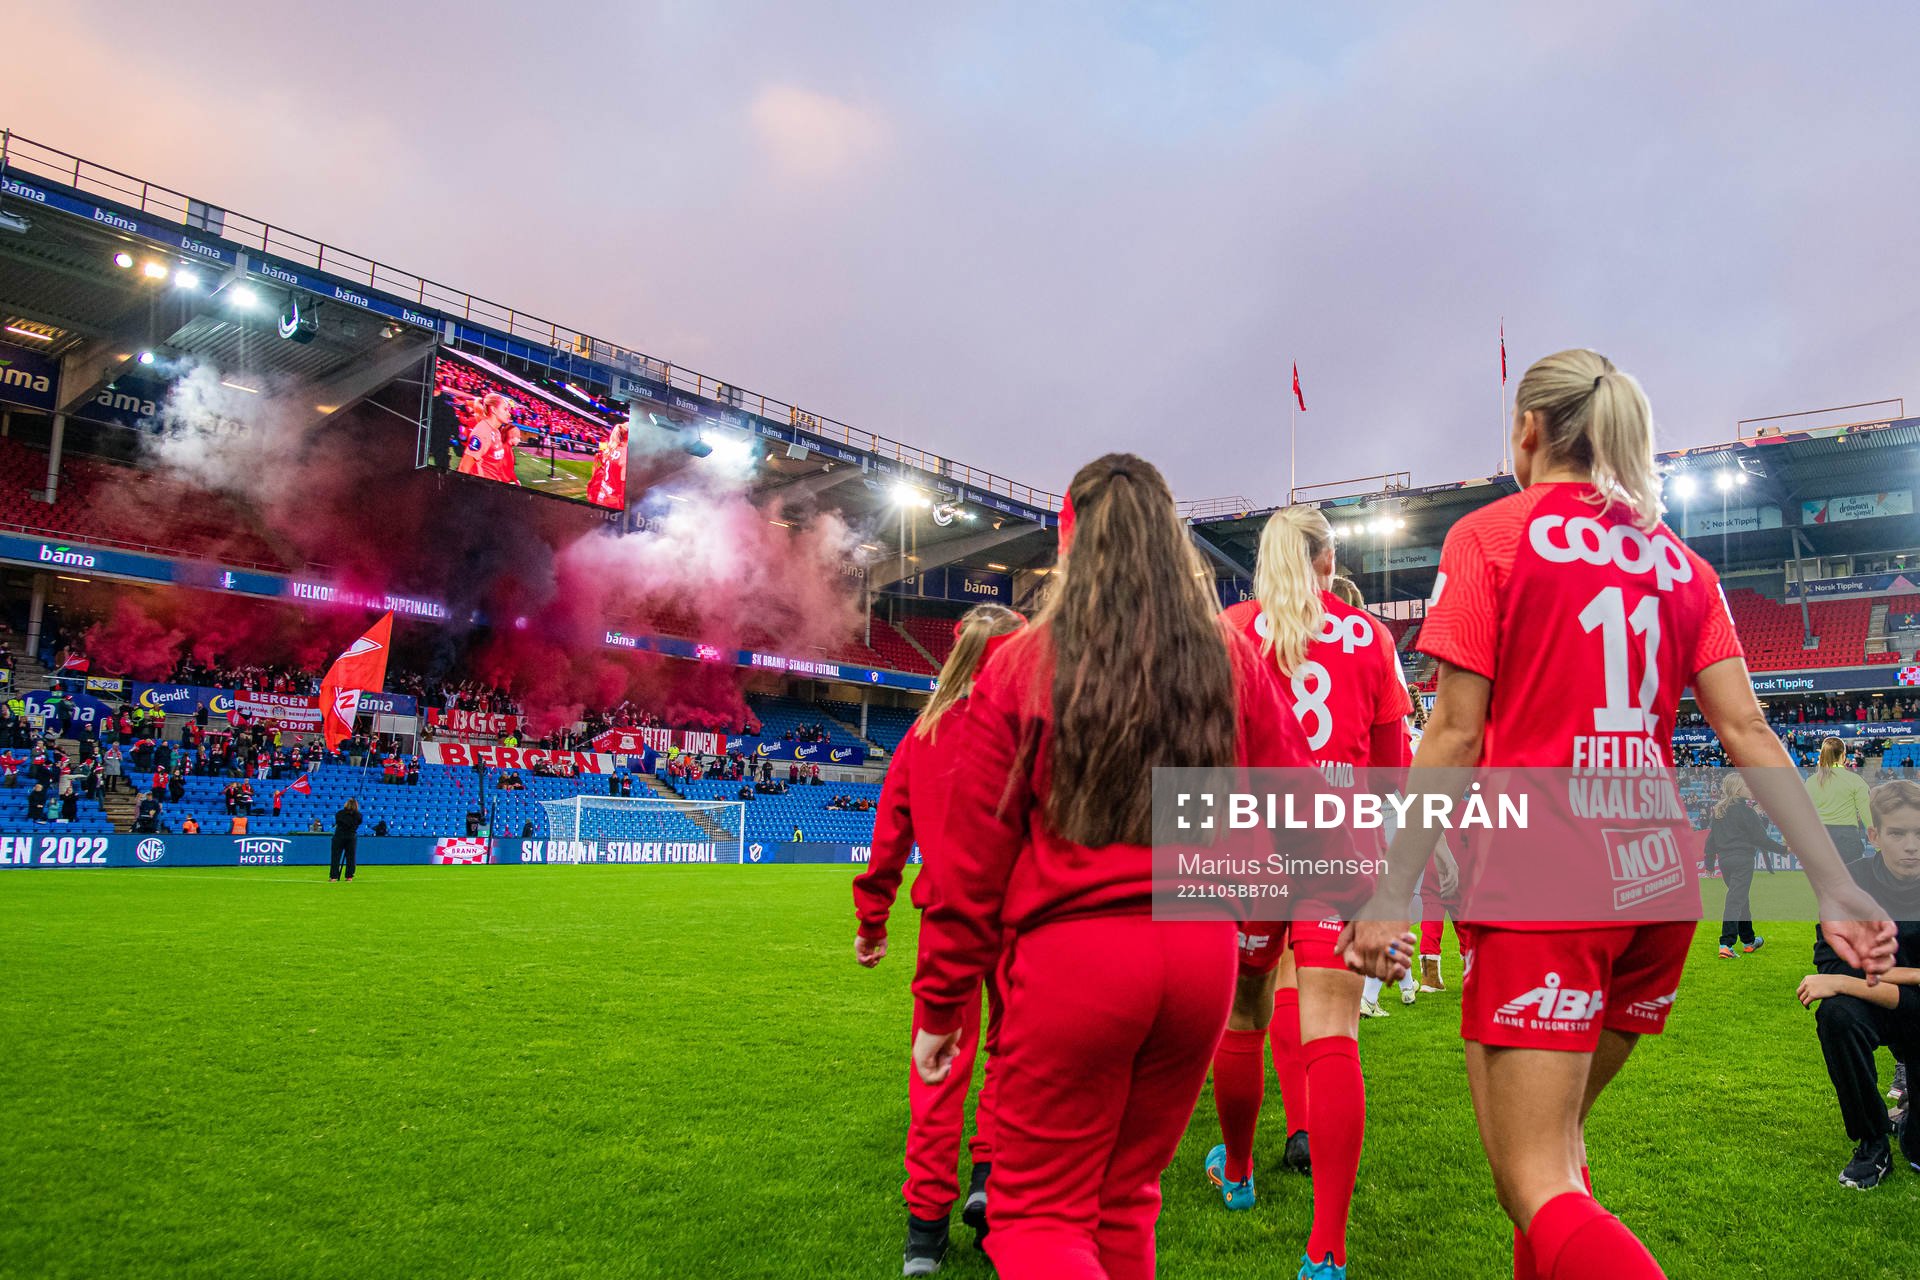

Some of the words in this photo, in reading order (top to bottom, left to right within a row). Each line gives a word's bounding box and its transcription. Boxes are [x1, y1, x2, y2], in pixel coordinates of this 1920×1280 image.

[1, 175, 46, 202] bama
[94, 207, 138, 232] bama
[181, 236, 221, 259] bama
[261, 263, 298, 285] bama
[335, 287, 369, 307] bama
[402, 309, 434, 329] bama
[0, 364, 50, 393] ma
[628, 382, 653, 398] bama
[675, 397, 699, 412] bama
[720, 411, 742, 426] bama
[762, 425, 782, 440] bama
[801, 438, 820, 452] bama
[838, 450, 857, 463] bama
[1712, 519, 1733, 529] Norsk
[1734, 517, 1761, 528] Tipping
[40, 544, 96, 568] bama
[1528, 513, 1693, 593] coop
[840, 563, 864, 579] ama
[963, 578, 999, 596] bama
[1814, 583, 1836, 592] Norsk
[1837, 581, 1863, 592] Tipping
[605, 631, 636, 647] bama
[752, 653, 763, 666] SK
[816, 662, 840, 677] FOTBALL
[1577, 586, 1661, 737] 11
[102, 681, 119, 690] 228
[1776, 678, 1814, 692] Tipping
[151, 688, 190, 704] Bendit
[250, 692, 309, 707] BERGEN
[25, 697, 96, 722] baa
[1291, 661, 1334, 752] 8
[1816, 728, 1841, 737] Tipping
[1867, 726, 1887, 734] Norsk
[1887, 725, 1912, 735] Tipping
[1684, 734, 1707, 743] Tipping
[762, 741, 782, 753] Bendit
[800, 745, 818, 756] Bendit
[835, 747, 852, 759] Bendit
[439, 743, 600, 775] BERGEN
[40, 837, 108, 864] 2022
[234, 837, 292, 853] THON
[522, 840, 543, 863] SK
[665, 842, 717, 863] FOTBALL
[240, 855, 284, 864] HOTELS
[1617, 829, 1677, 879] MOT
[1626, 1004, 1660, 1022] ÅSANE
